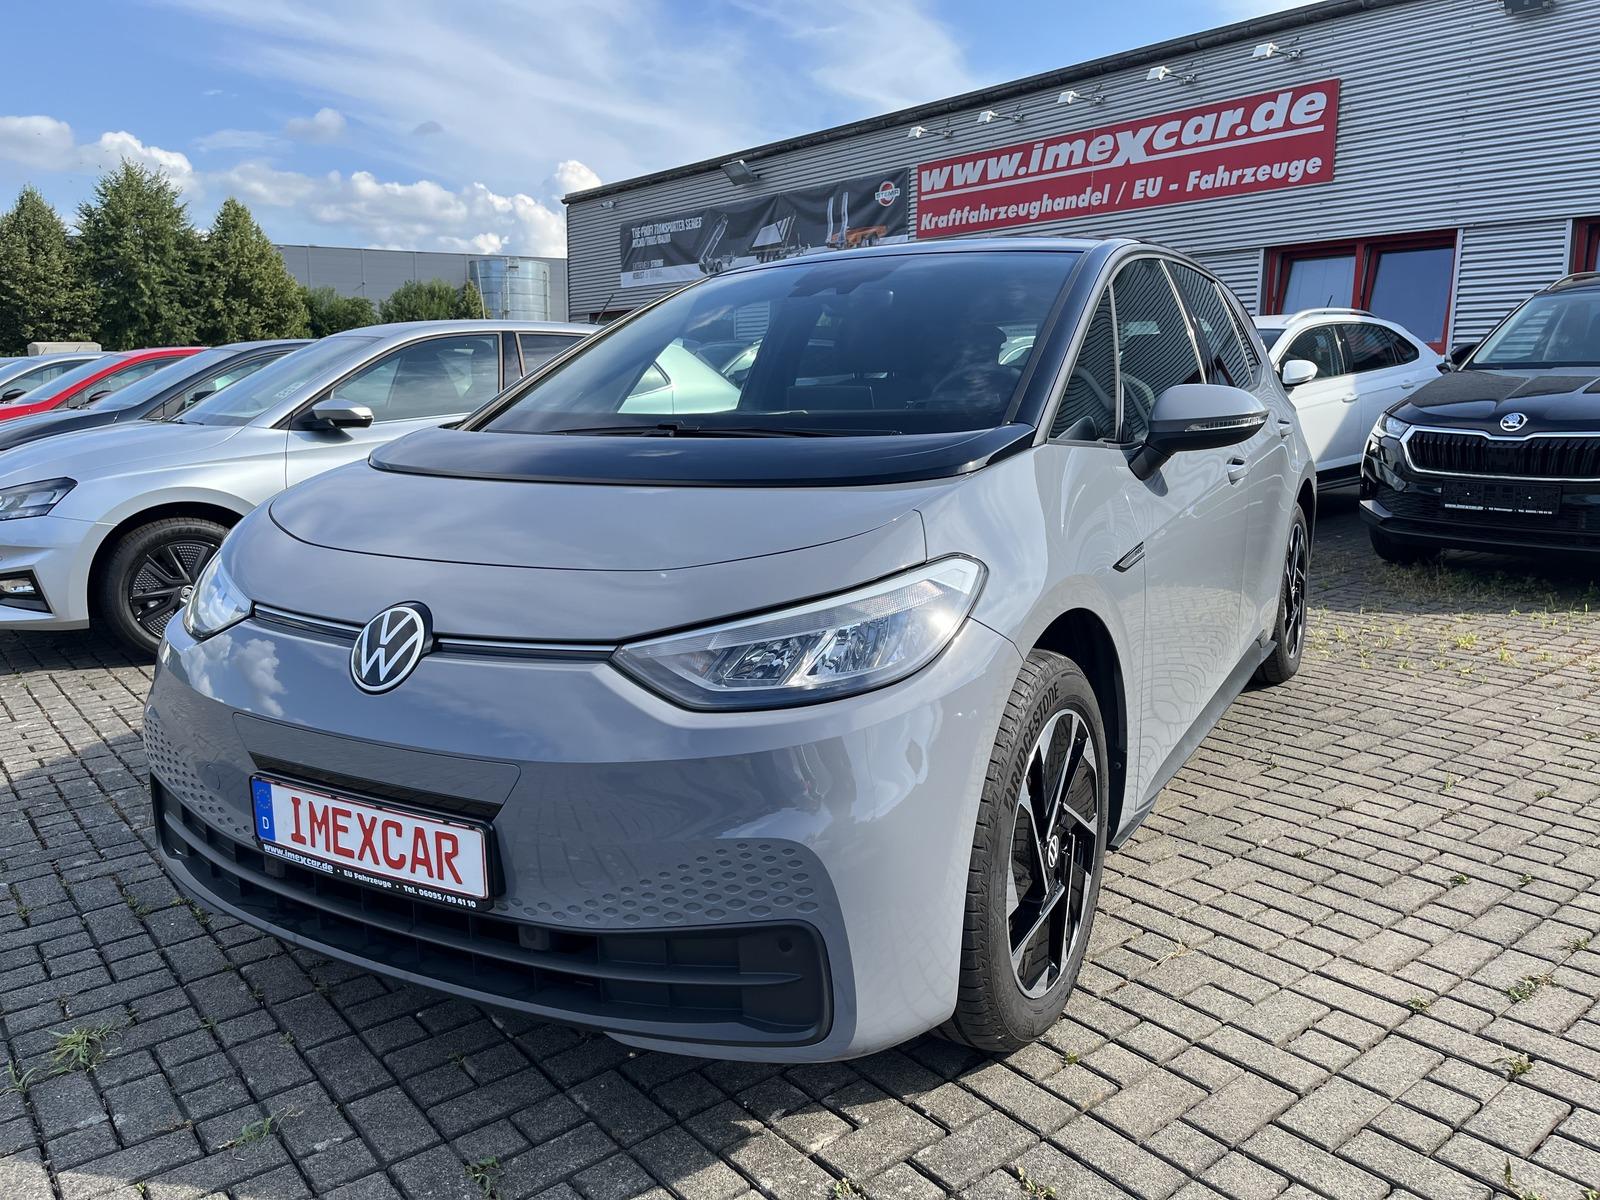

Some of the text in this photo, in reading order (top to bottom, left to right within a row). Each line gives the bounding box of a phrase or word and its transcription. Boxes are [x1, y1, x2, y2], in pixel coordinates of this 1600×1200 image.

[921, 90, 1328, 193] www.imexcar.de
[920, 183, 1111, 231] Kraftfahrzeughandel
[1132, 176, 1163, 200] EU
[1186, 156, 1322, 192] Fahrzeuge
[1004, 681, 1059, 813] BRIDGESTONE
[262, 816, 270, 830] D
[291, 796, 463, 885] IMEXCAR
[263, 843, 334, 873] www.imexcar.de
[343, 870, 392, 888] EU Fahrzeuge
[403, 885, 418, 895] Tel.
